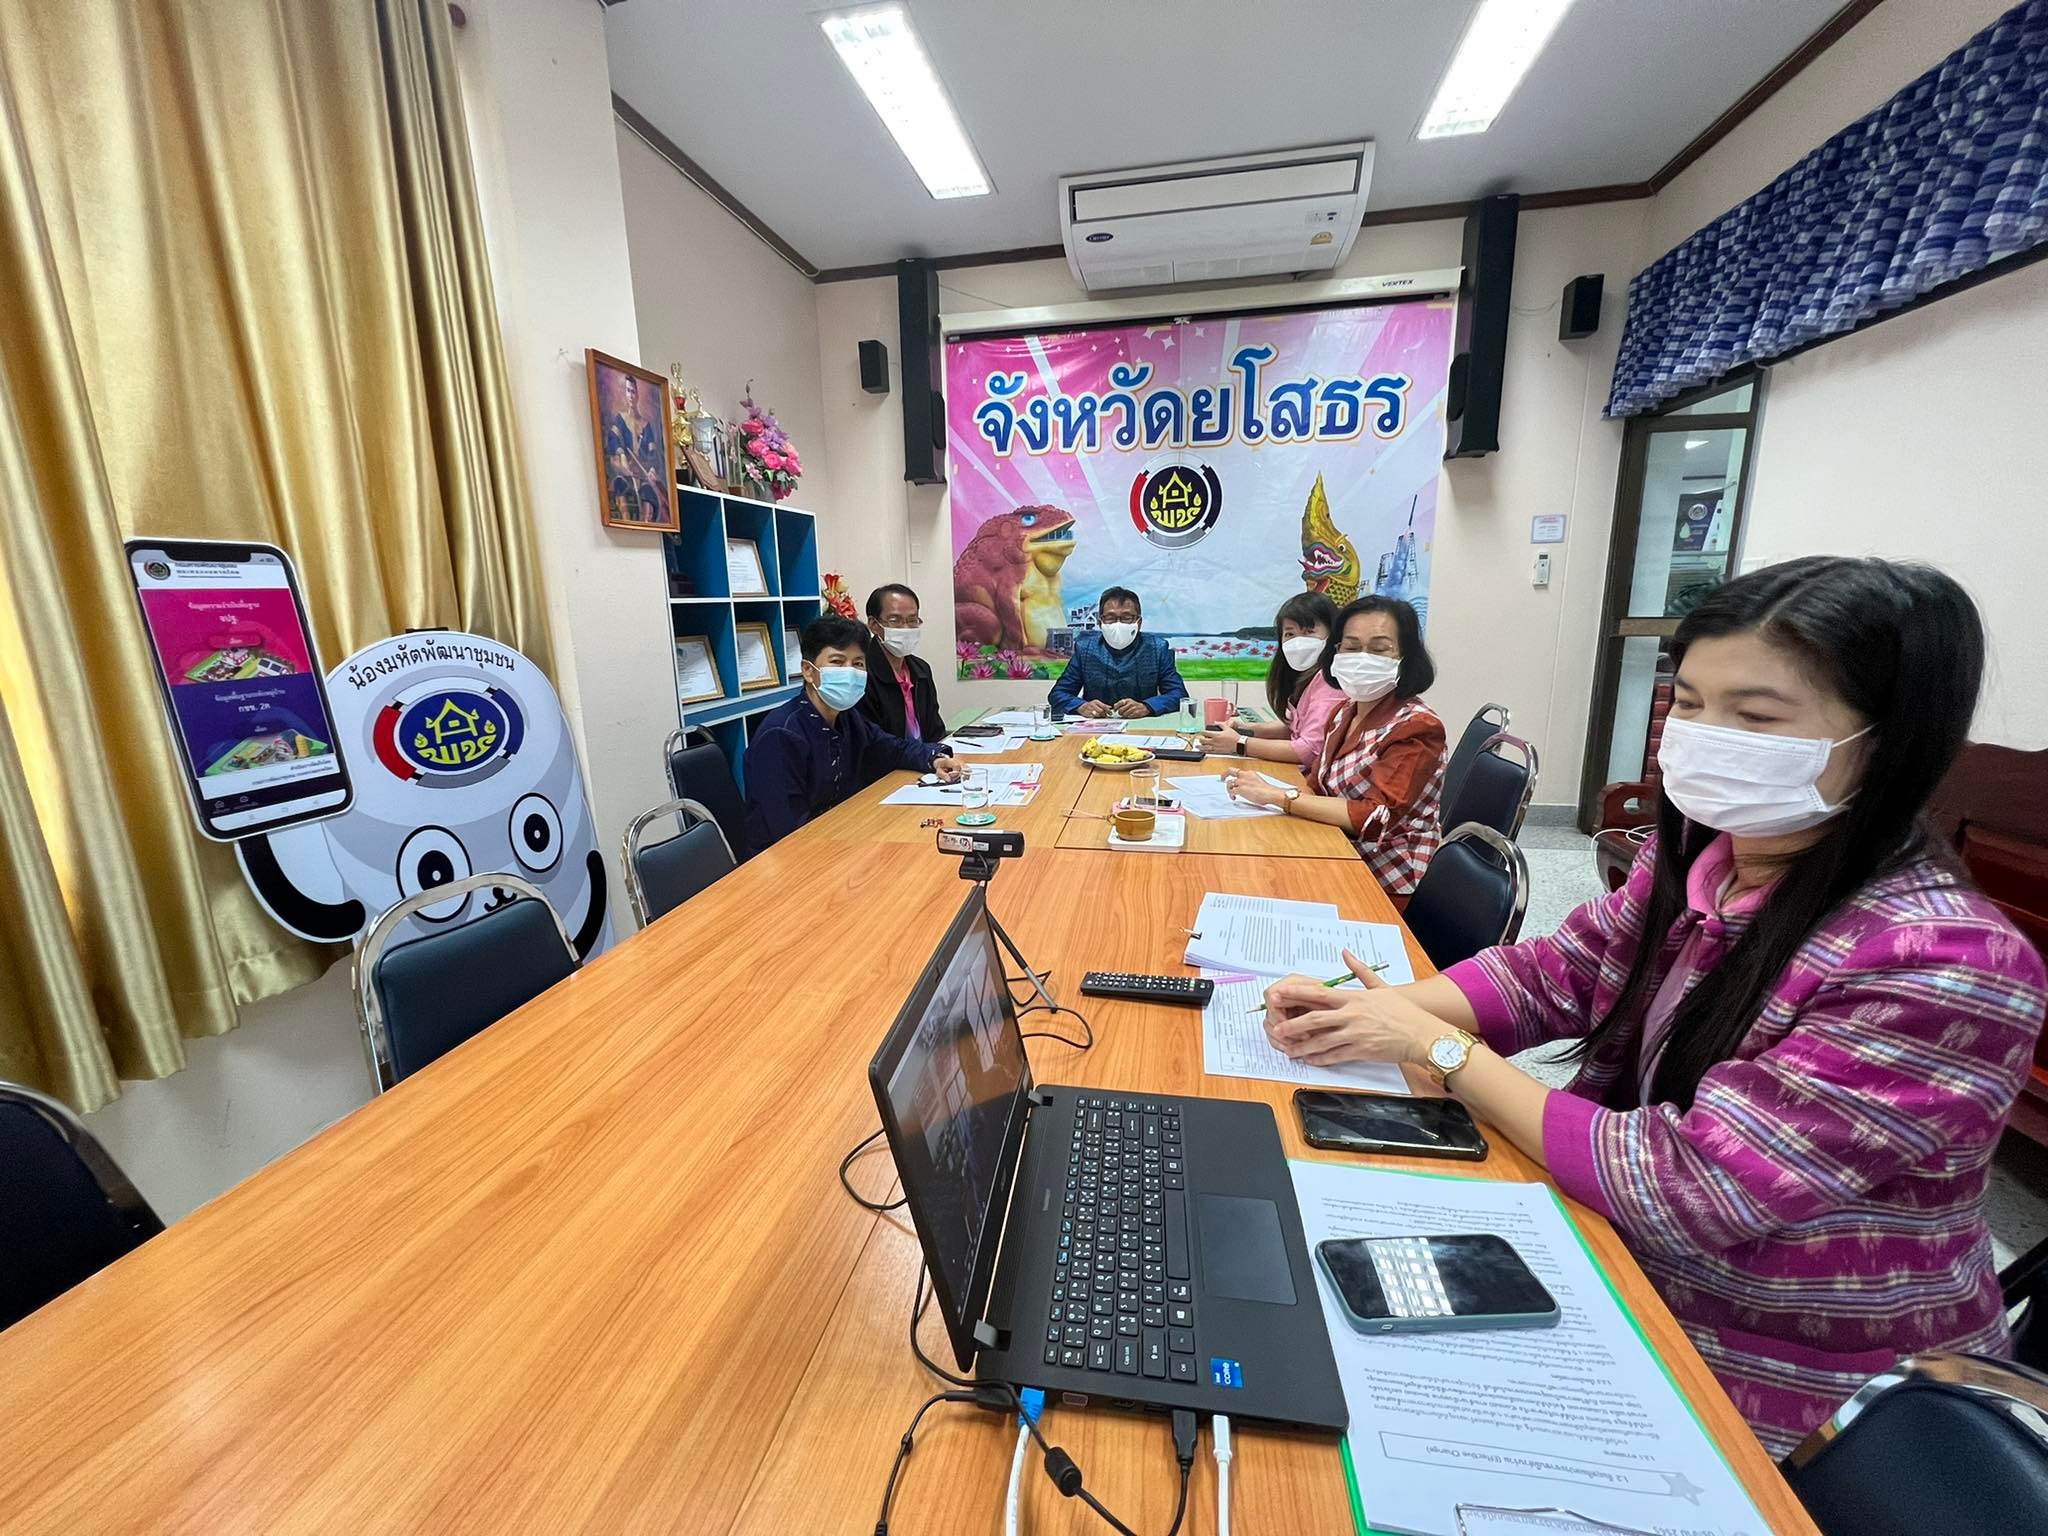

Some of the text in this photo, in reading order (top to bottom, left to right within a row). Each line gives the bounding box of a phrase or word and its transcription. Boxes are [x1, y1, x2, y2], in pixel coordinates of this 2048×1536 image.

[1381, 278, 1415, 287] VERTEX
[976, 343, 1412, 455] จังหวัดยโสธร
[348, 639, 515, 690] น้องมหัตพัฒนาชุมชน
